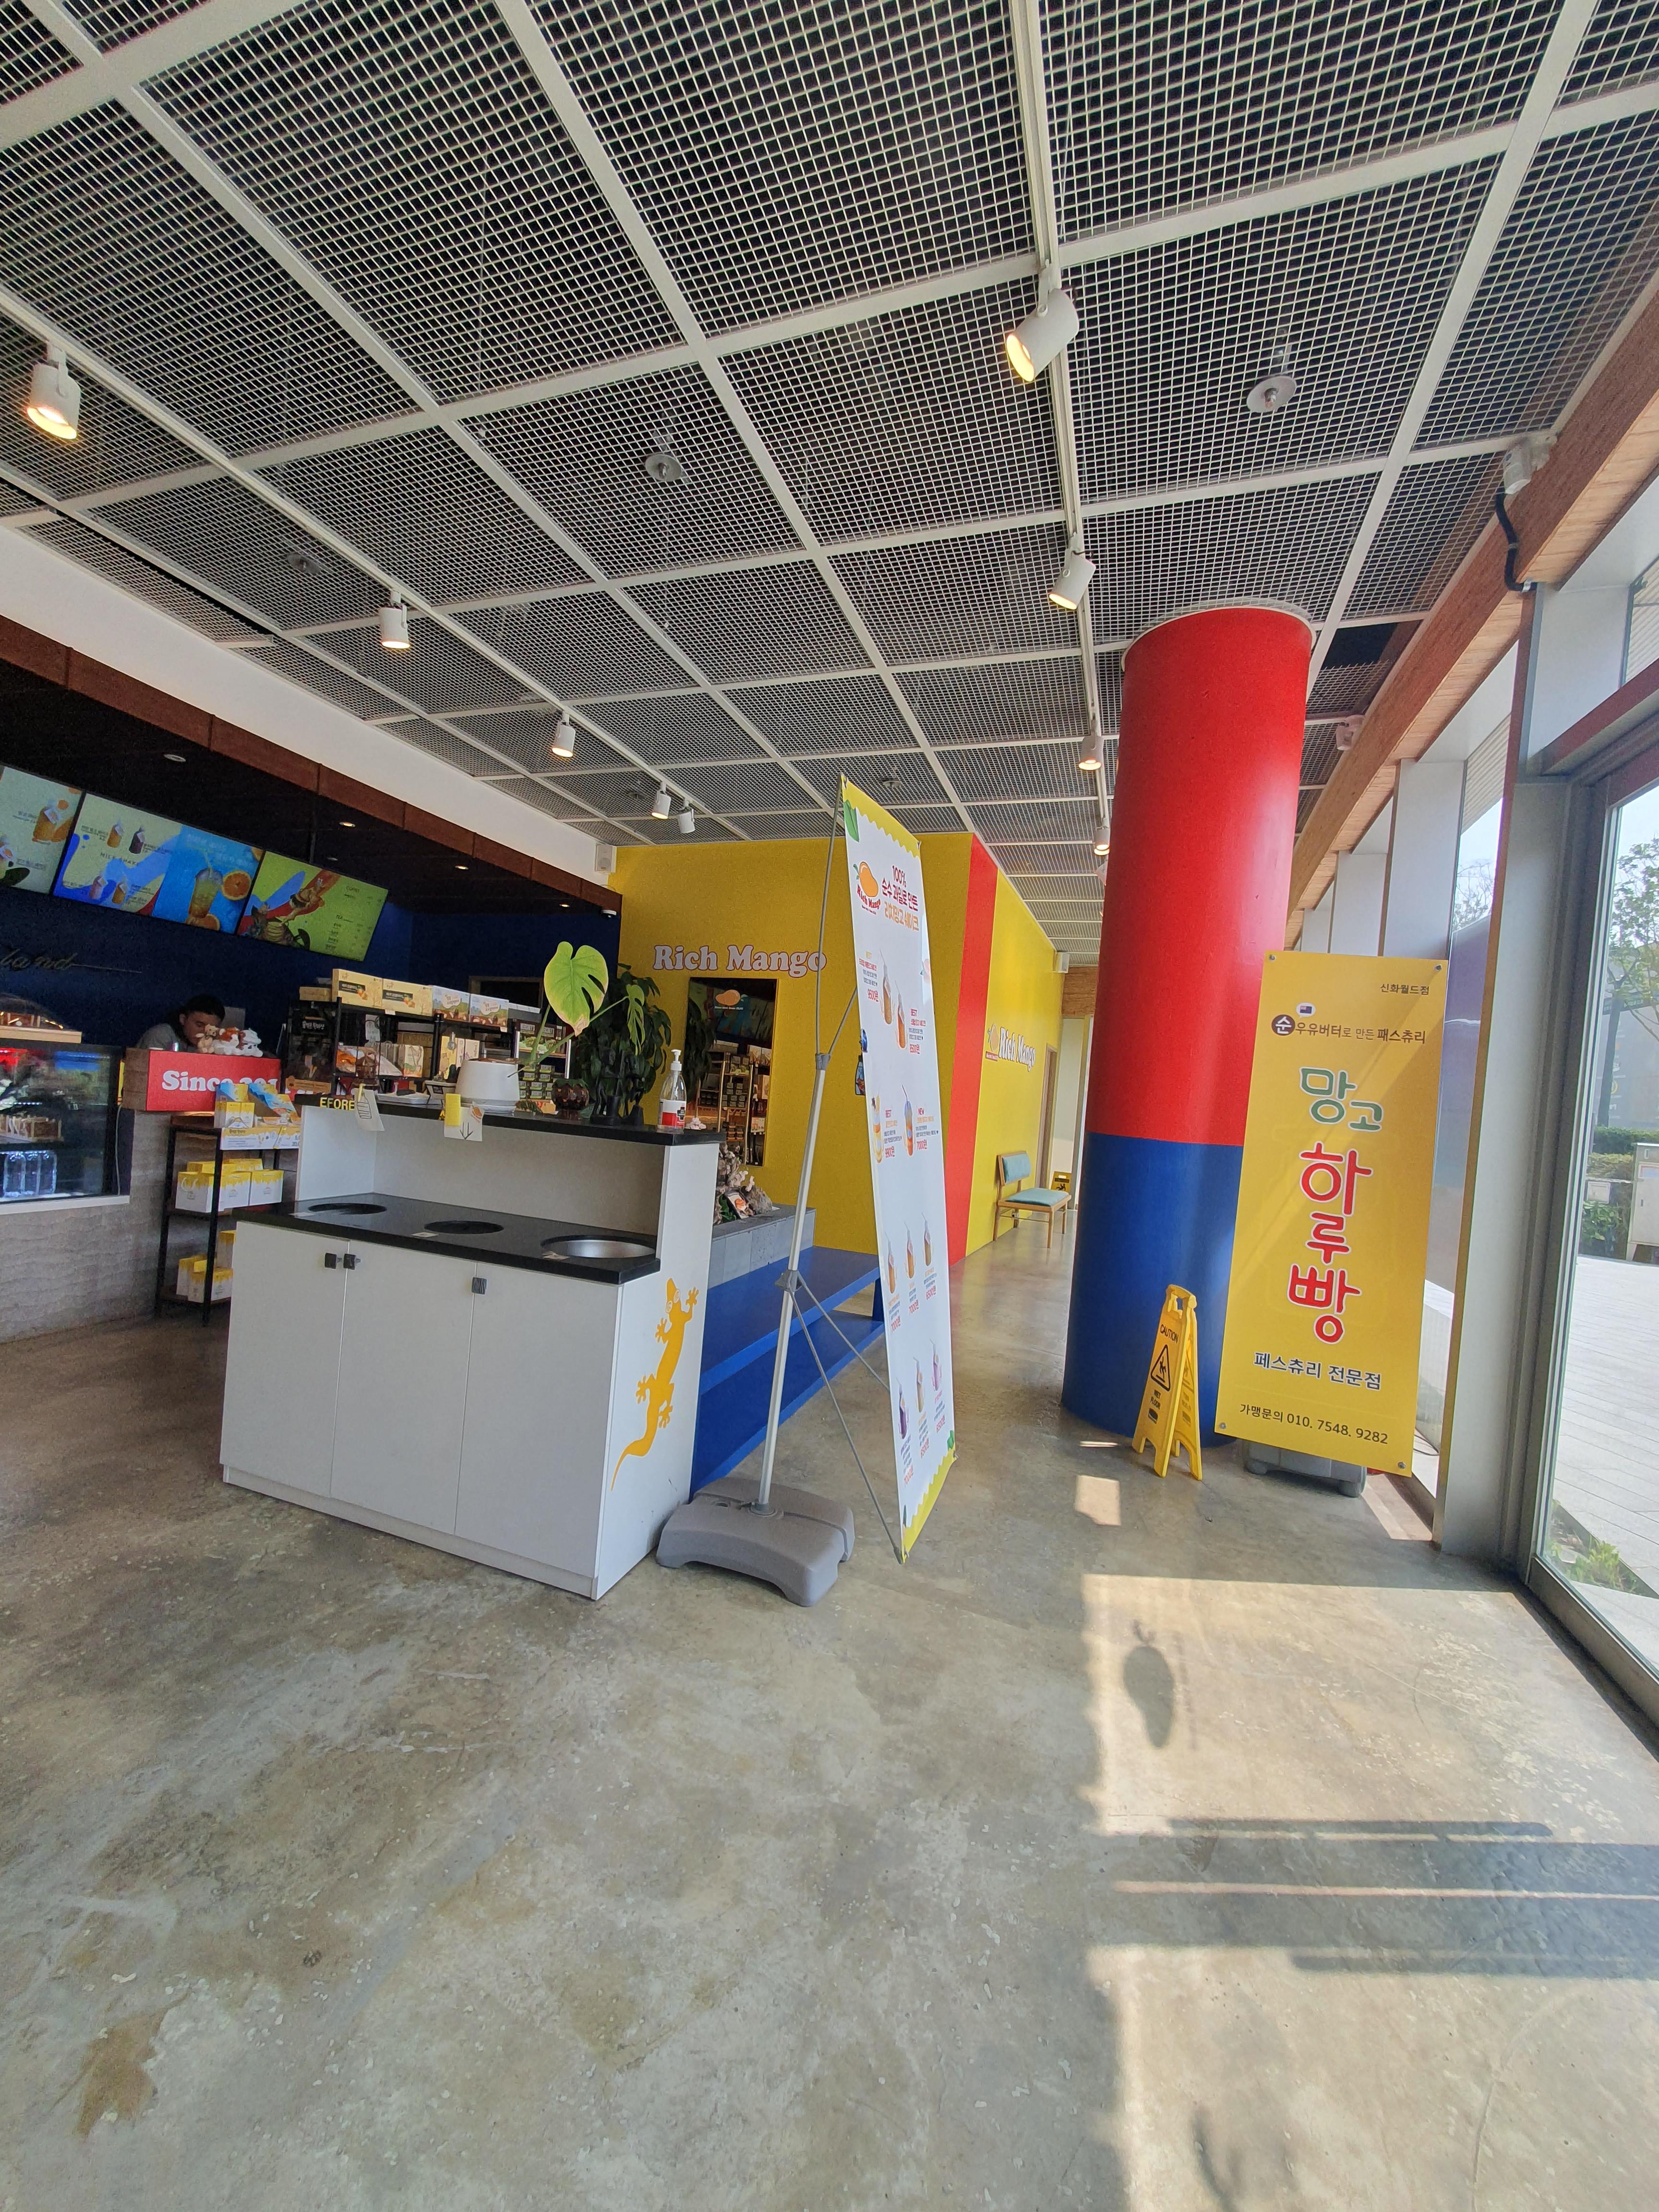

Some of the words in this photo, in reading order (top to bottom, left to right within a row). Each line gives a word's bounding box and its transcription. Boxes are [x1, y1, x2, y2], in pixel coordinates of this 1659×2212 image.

[892, 865, 906, 888] 100%
[857, 883, 868, 905] Rich
[882, 877, 892, 898] 순수
[893, 884, 908, 906] 과일로
[908, 892, 918, 912] 만든
[884, 901, 904, 925] 리치망고
[904, 910, 919, 931] 쉐이크
[652, 945, 718, 971] Rich
[726, 945, 827, 978] Mango
[1380, 983, 1430, 996] 신화월드점
[998, 1026, 1016, 1062] Rich
[1016, 1034, 1035, 1072] Mango
[1355, 1028, 1375, 1041] 만든
[1376, 1028, 1426, 1045] 패스츄리
[1299, 1066, 1383, 1133] 망고
[1287, 1142, 1373, 1344] 하루빵
[1160, 1323, 1179, 1344] CAUTION
[1254, 1351, 1322, 1379] 페스츄리
[1328, 1365, 1381, 1391] 전문점
[1150, 1396, 1161, 1410] FLOOR
[1240, 1404, 1283, 1422] 가맹문의
[1286, 1413, 1313, 1429] 010.
[1317, 1419, 1352, 1438] 7548.
[1355, 1428, 1388, 1444] 9282
